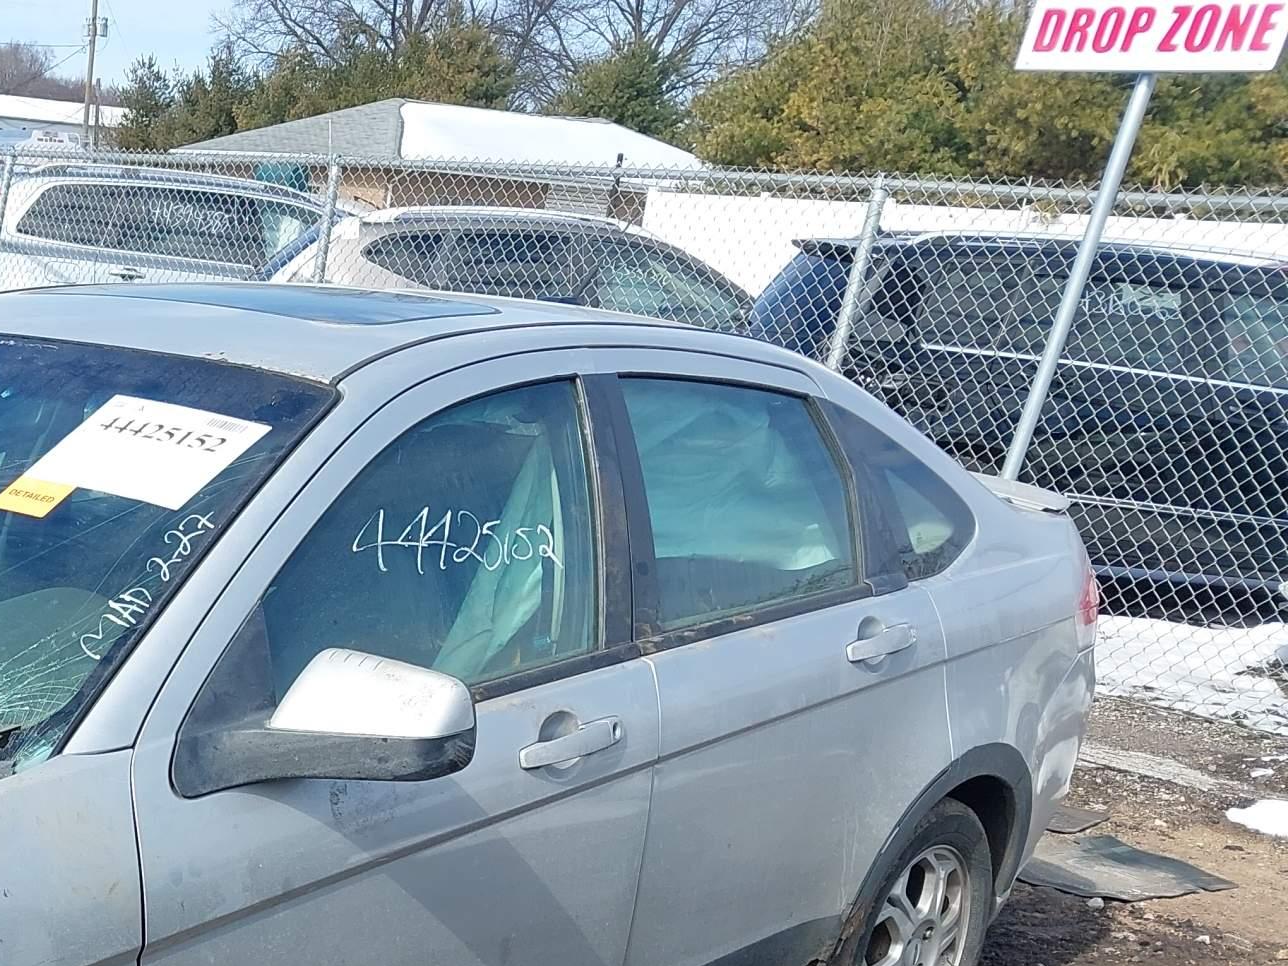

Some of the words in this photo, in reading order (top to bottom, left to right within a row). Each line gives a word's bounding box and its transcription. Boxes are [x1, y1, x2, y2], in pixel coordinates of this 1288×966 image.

[1032, 6, 1157, 54] DROP
[1156, 2, 1286, 53] ZONE
[99, 416, 228, 453] 44425152
[8, 488, 55, 504] DETAILED
[352, 506, 564, 575] 44425152
[80, 587, 153, 660] MAD
